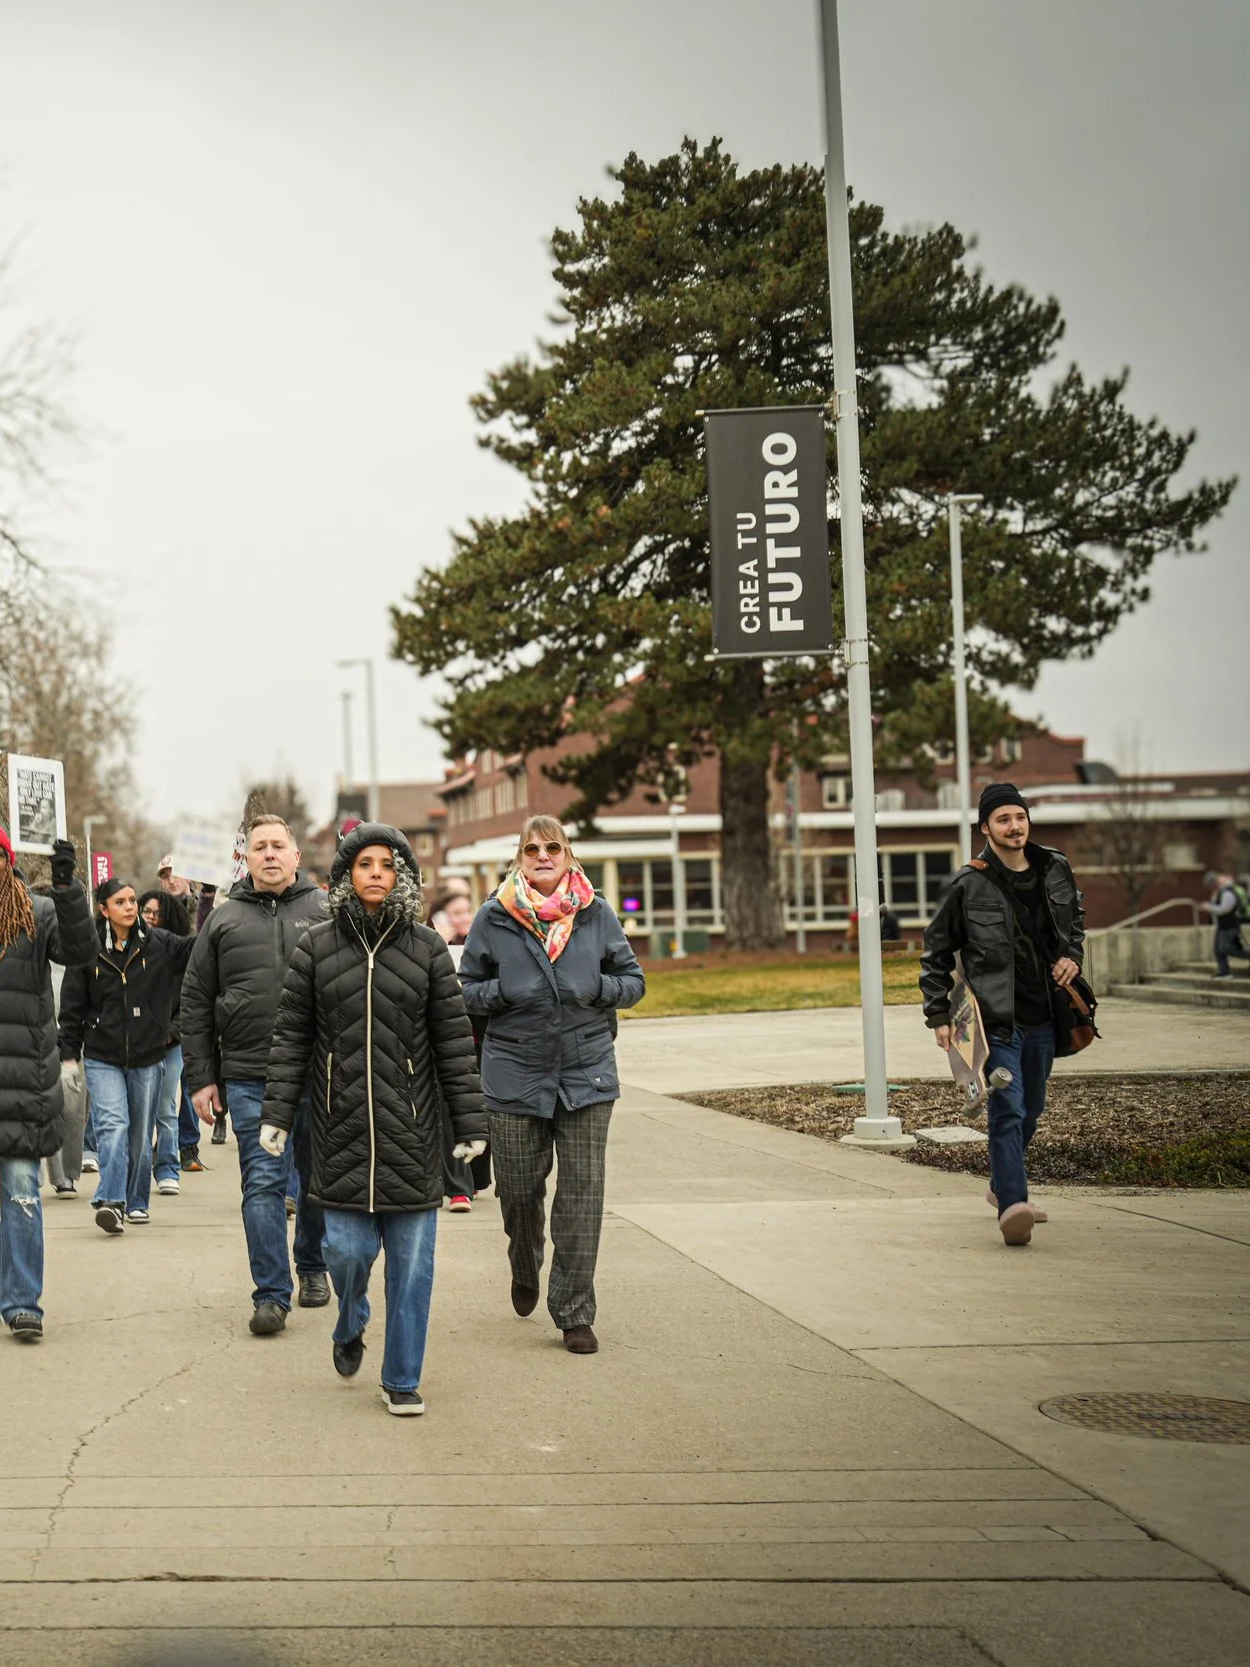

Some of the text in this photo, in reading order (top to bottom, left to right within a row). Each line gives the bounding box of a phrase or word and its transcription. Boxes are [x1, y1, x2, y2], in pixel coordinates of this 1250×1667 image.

[736, 512, 760, 634] CREA TU
[762, 431, 804, 632] FUTURO
